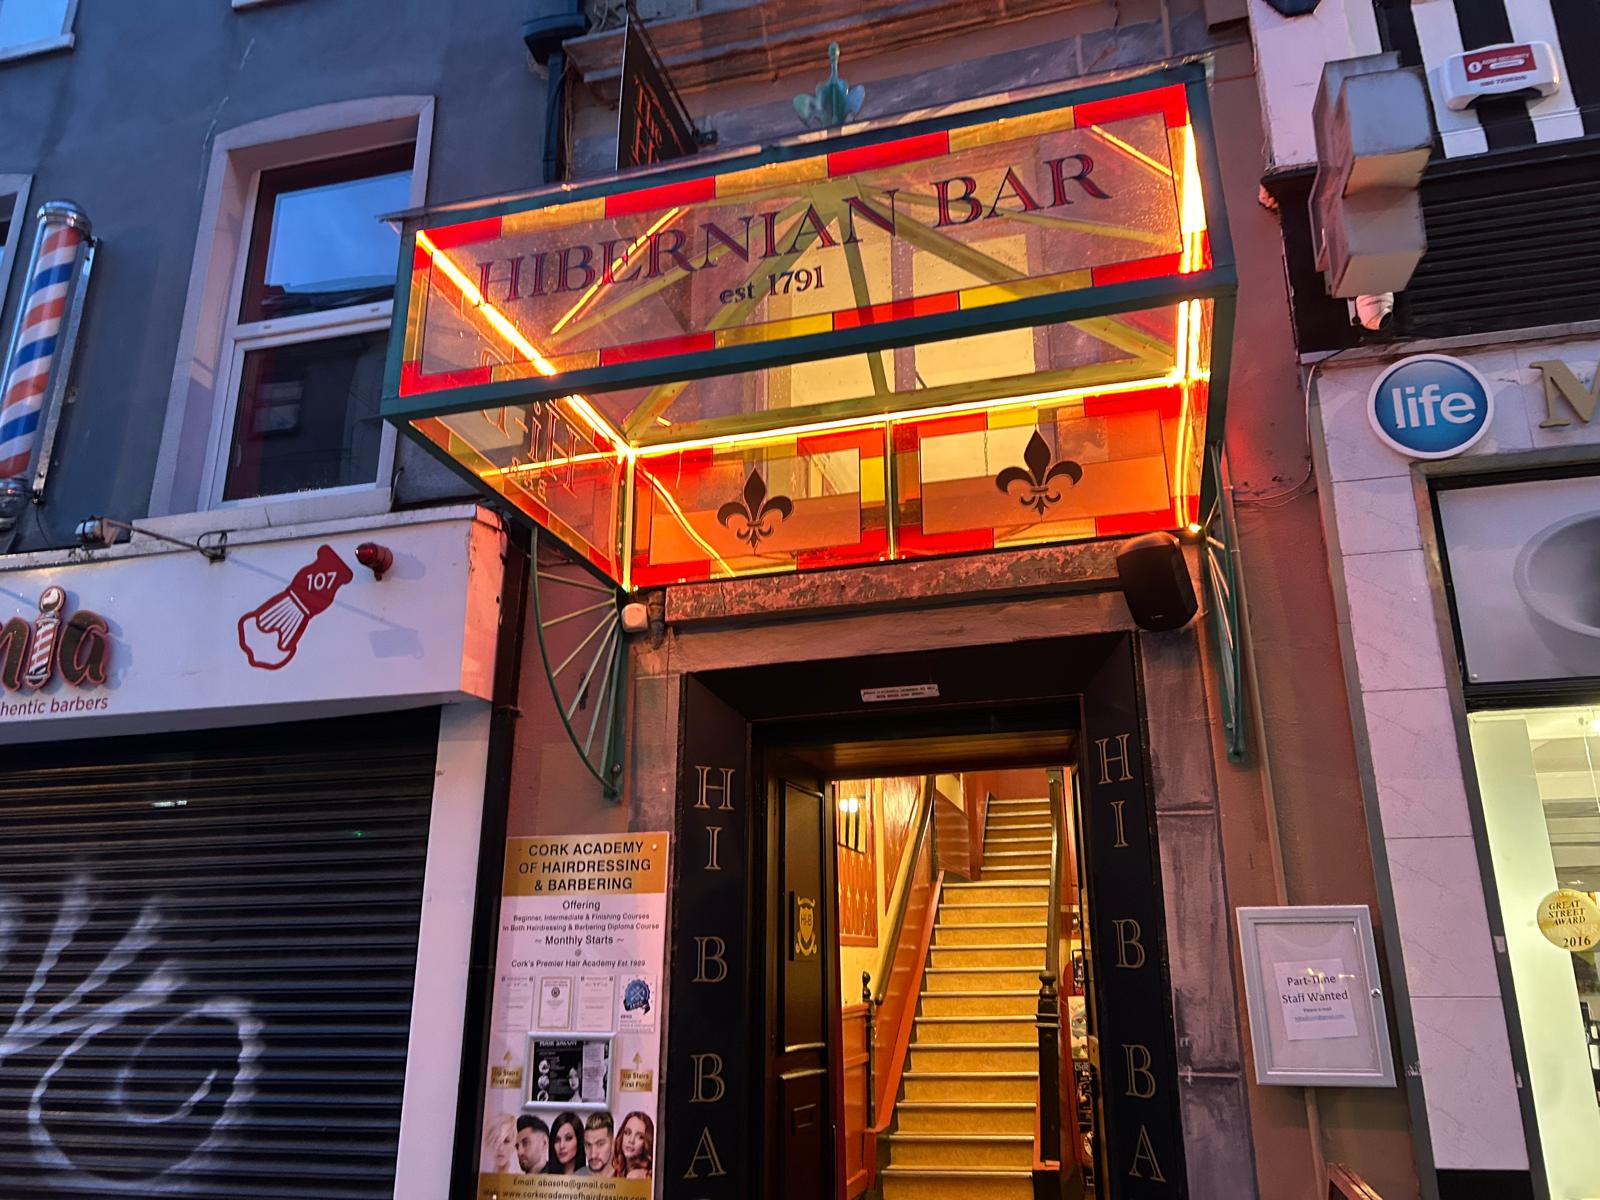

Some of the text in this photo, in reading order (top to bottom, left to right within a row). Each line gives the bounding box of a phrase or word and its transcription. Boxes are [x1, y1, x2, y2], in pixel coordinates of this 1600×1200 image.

[476, 152, 1112, 308] HIBERNIAN BAR
[719, 265, 825, 306] est 1791
[1391, 383, 1477, 429] life
[306, 571, 337, 591] 107
[50, 695, 109, 713] barbers
[528, 841, 644, 857] CORK ACADEMY
[519, 858, 652, 874] OF HAIRDRESSING
[534, 877, 633, 892] & BARBERING
[562, 900, 601, 911] Offering
[1548, 899, 1581, 911] GREAT
[513, 915, 542, 923] Beginner,
[544, 914, 584, 922] Intermediate
[591, 913, 622, 922] Finishing
[1548, 907, 1585, 919] STREET
[1552, 915, 1586, 927] AWARD
[526, 924, 567, 933] Hairdressing
[574, 924, 606, 932] Barbering
[607, 923, 635, 932] Diploma
[635, 923, 660, 931] Course
[545, 934, 614, 947] Monthly Starts
[1563, 935, 1591, 948] 2016
[511, 959, 535, 968] Cork's
[536, 959, 565, 968] Premier
[565, 959, 580, 968] Hair
[582, 958, 616, 968] Academy
[1281, 989, 1349, 1005] Staff Wanted
[513, 1178, 536, 1188] Email:
